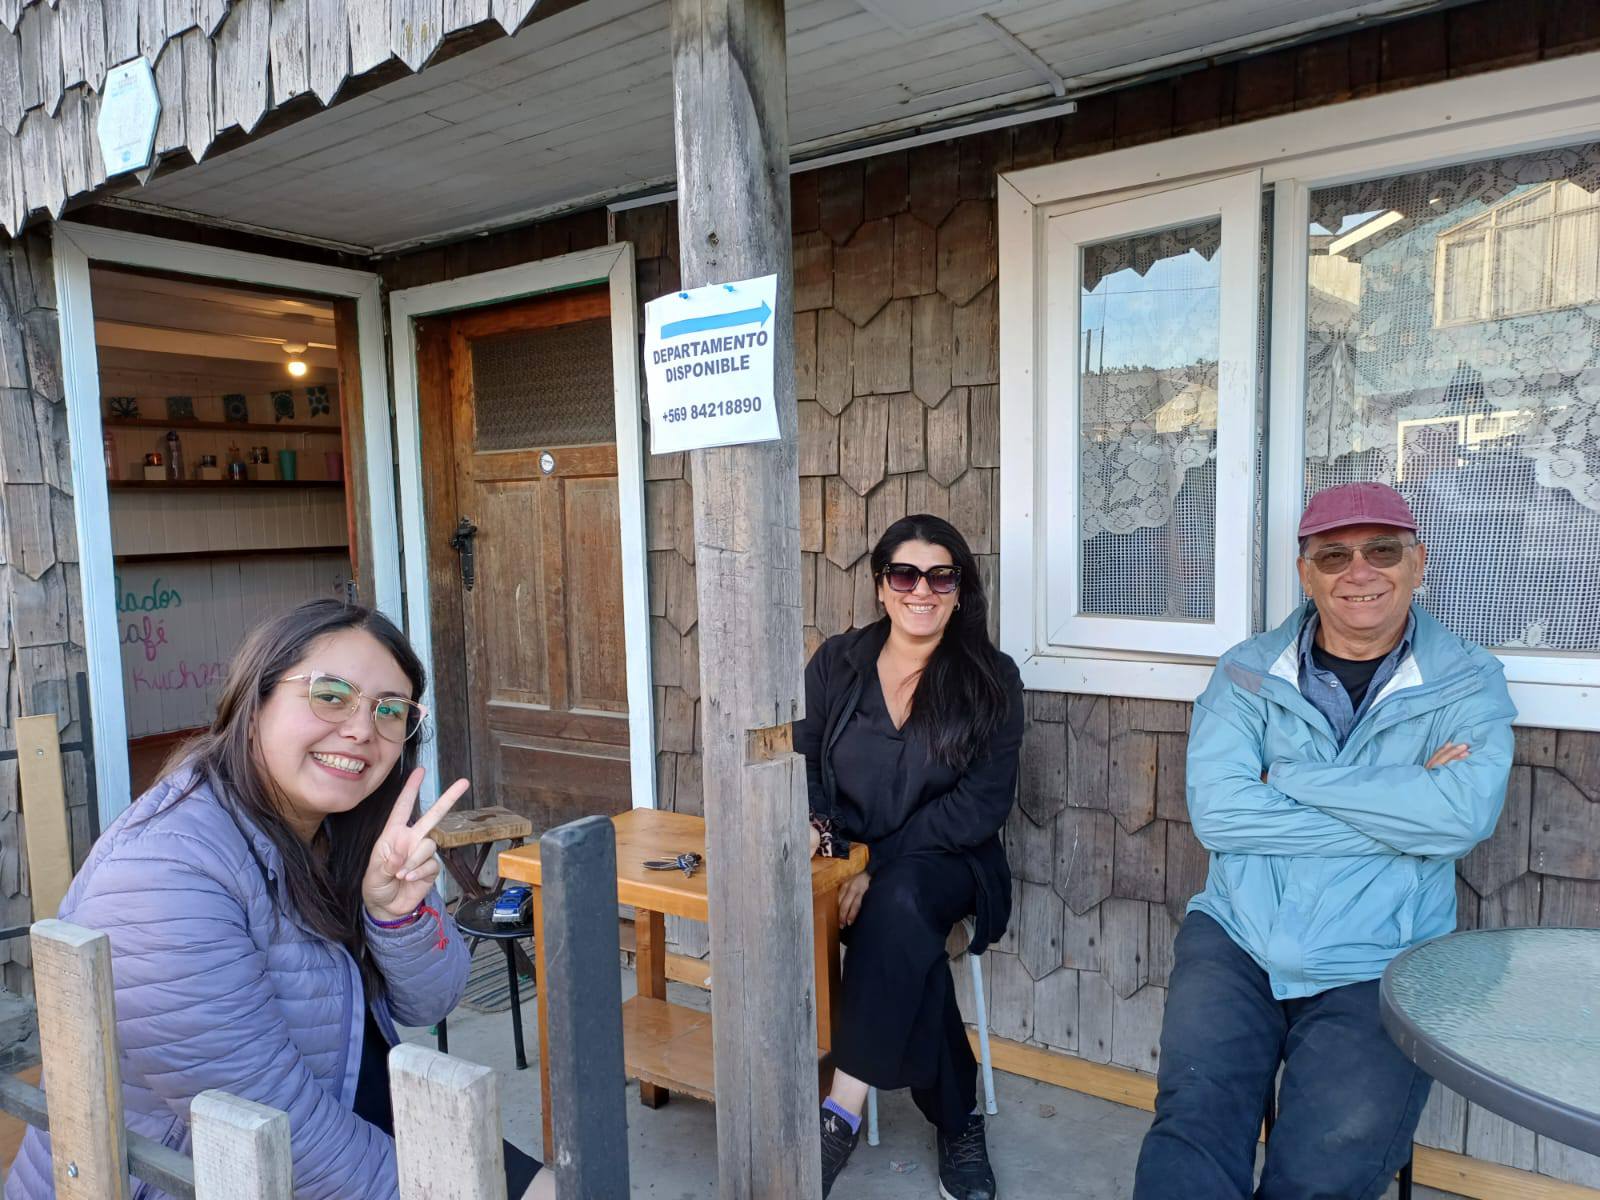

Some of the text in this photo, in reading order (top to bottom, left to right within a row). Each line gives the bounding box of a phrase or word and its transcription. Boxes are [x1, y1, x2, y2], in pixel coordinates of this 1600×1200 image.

[653, 331, 768, 364] DEPARTAMENTO
[666, 355, 750, 383] DISPONIBLE
[663, 397, 761, 423] +569 84218890
